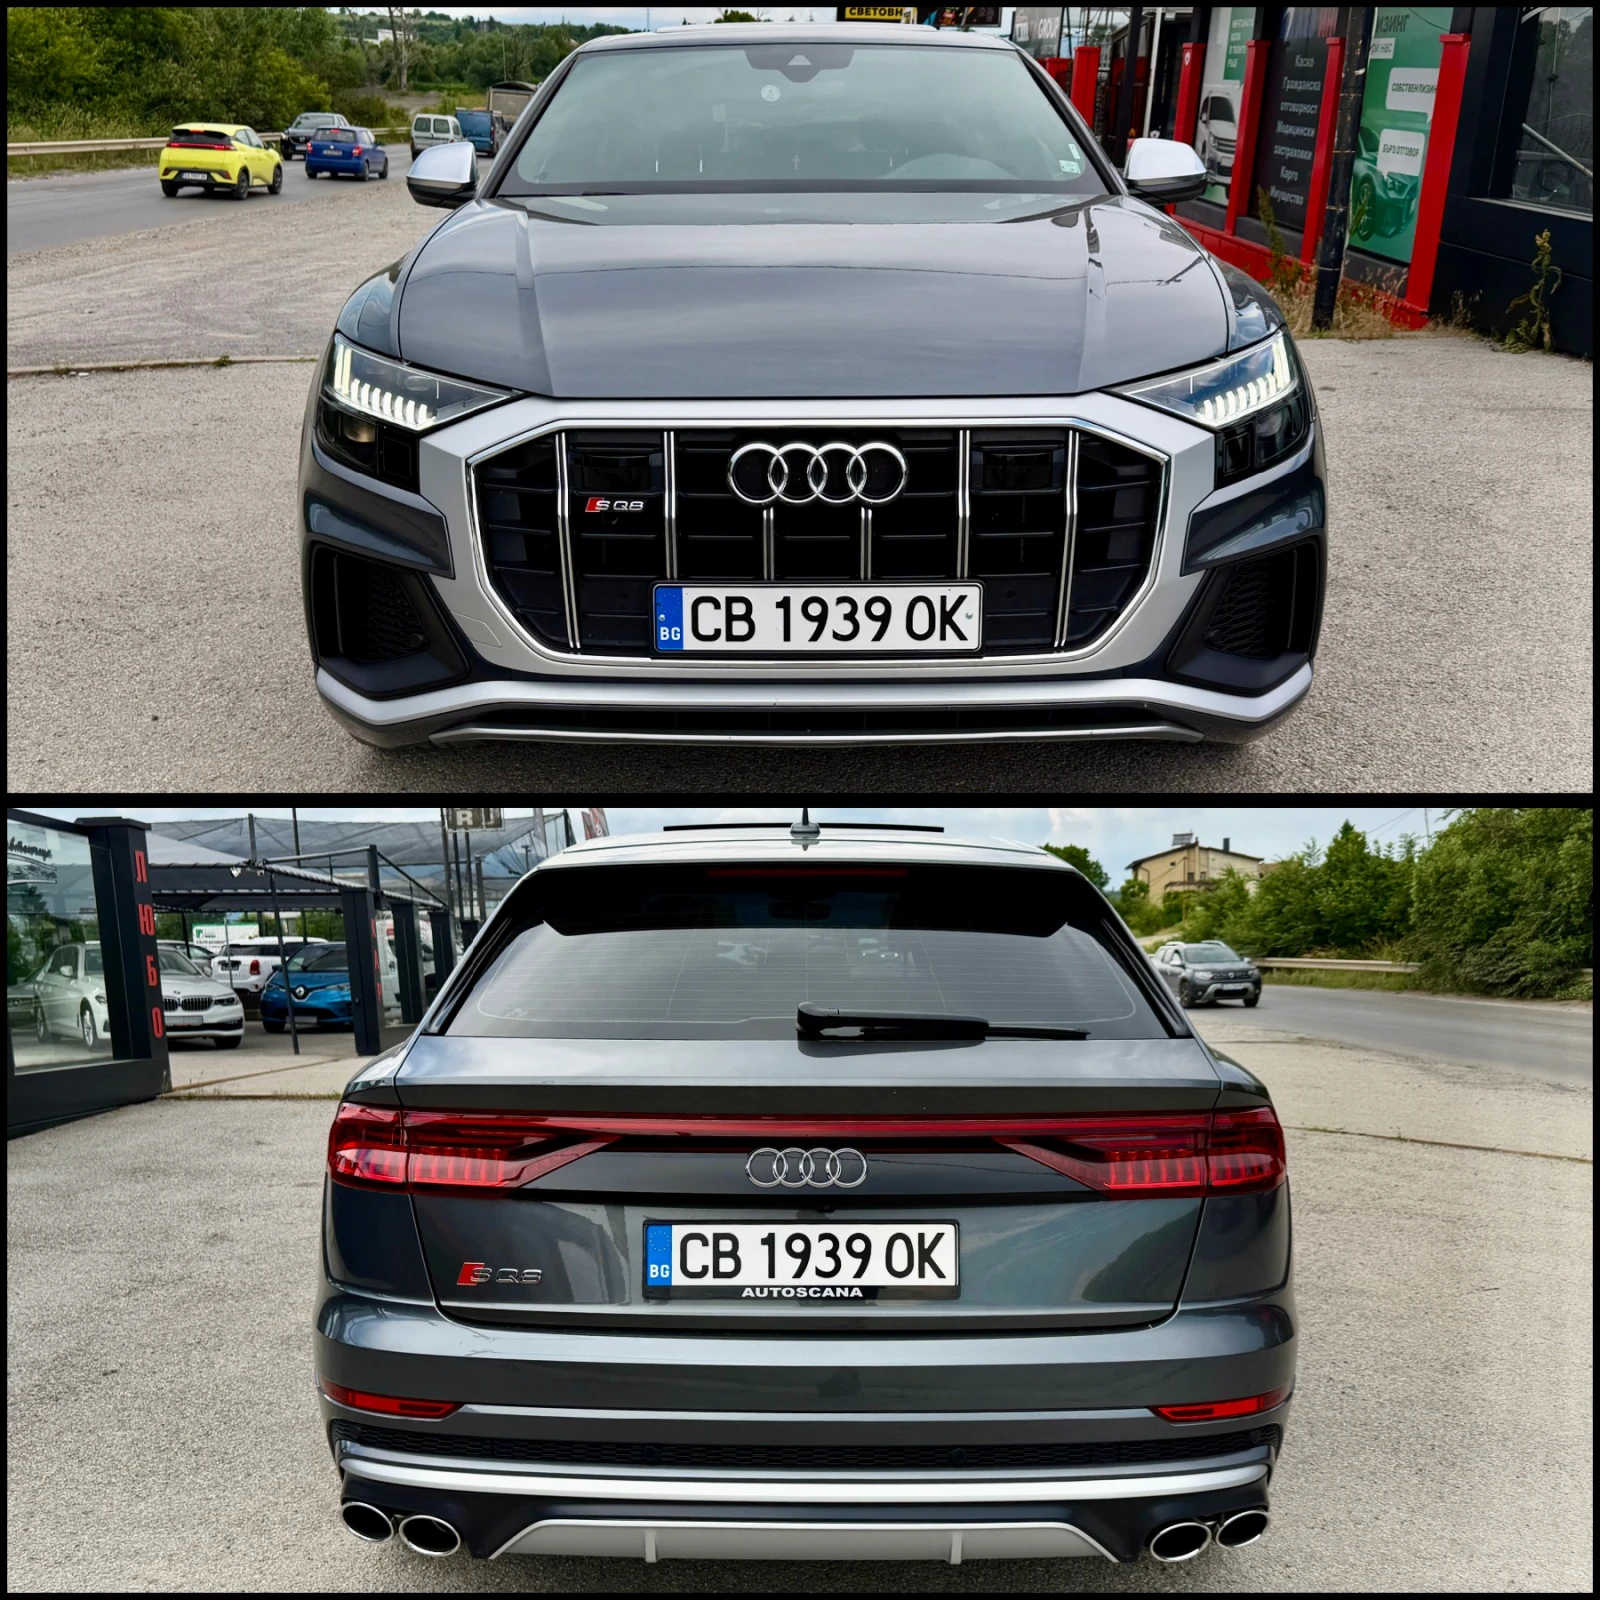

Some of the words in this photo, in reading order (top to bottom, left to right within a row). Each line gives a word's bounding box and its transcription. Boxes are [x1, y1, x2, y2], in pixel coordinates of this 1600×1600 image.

[849, 7, 903, 17] СВЕТОВН
[1375, 14, 1410, 33] ИЗИНГ
[1294, 55, 1315, 67] Каско
[1282, 76, 1321, 92] Гражданска
[1419, 84, 1437, 94] ЛИЗИН
[1280, 101, 1318, 116] отговорност
[1276, 120, 1315, 138] Медицински
[1273, 144, 1313, 161] застраховки
[1382, 144, 1398, 155] БЪРЗ
[1398, 145, 1420, 158] ОТГОВОР
[1280, 165, 1299, 183] Карго
[1269, 185, 1304, 206] Имущество
[592, 499, 644, 511] SQ8
[690, 596, 756, 642] CB
[775, 596, 893, 642] 1939
[905, 595, 969, 642] OK
[660, 627, 681, 641] BG
[134, 850, 164, 1039] ЛЮБО
[679, 1232, 742, 1279] CB
[760, 1232, 873, 1279] 1939
[885, 1232, 946, 1279] OK
[469, 1267, 543, 1285] SQ8
[649, 1264, 671, 1278] BG
[741, 1286, 863, 1298] AUTOSCANA
